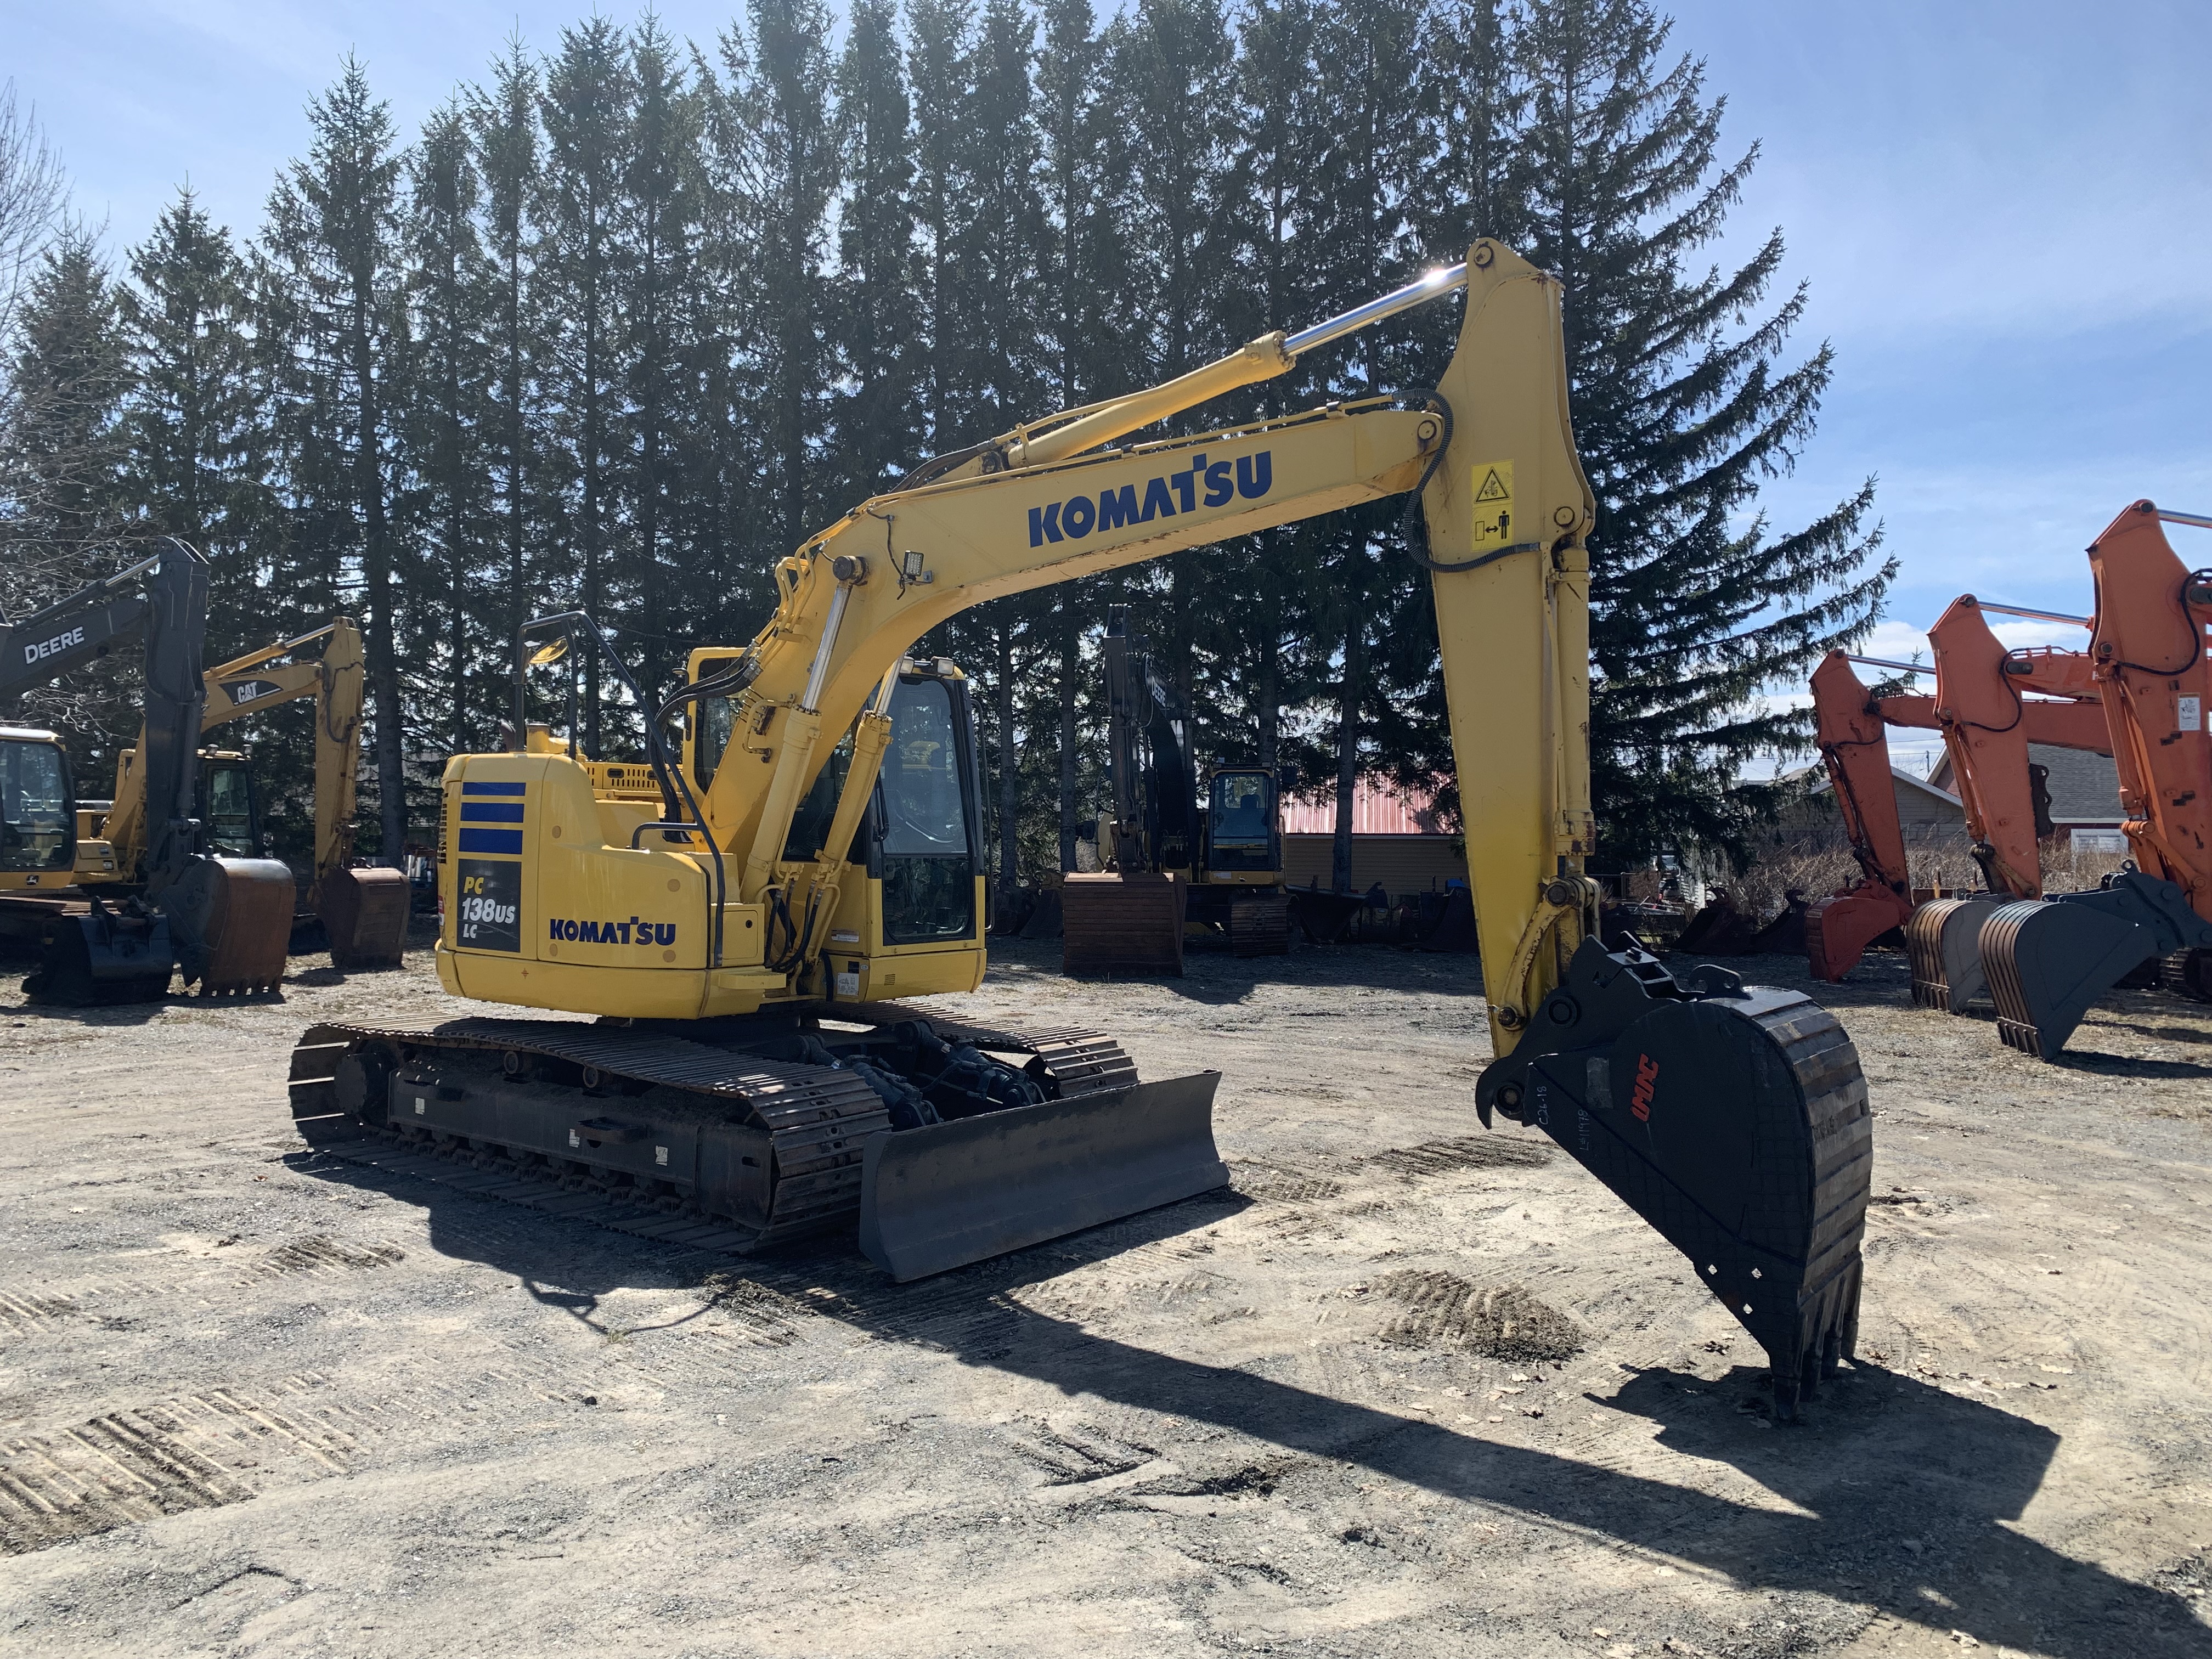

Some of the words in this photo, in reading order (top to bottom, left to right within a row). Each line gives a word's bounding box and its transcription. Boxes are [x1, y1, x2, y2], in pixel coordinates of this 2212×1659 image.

[1028, 450, 1272, 548] KOMATSU
[24, 626, 84, 664] DEERE
[237, 681, 257, 703] CAT
[1152, 675, 1166, 708] DEERE
[463, 876, 484, 895] PC
[462, 898, 516, 924] 138US
[462, 923, 477, 938] LC
[550, 916, 676, 946] KOMATSU
